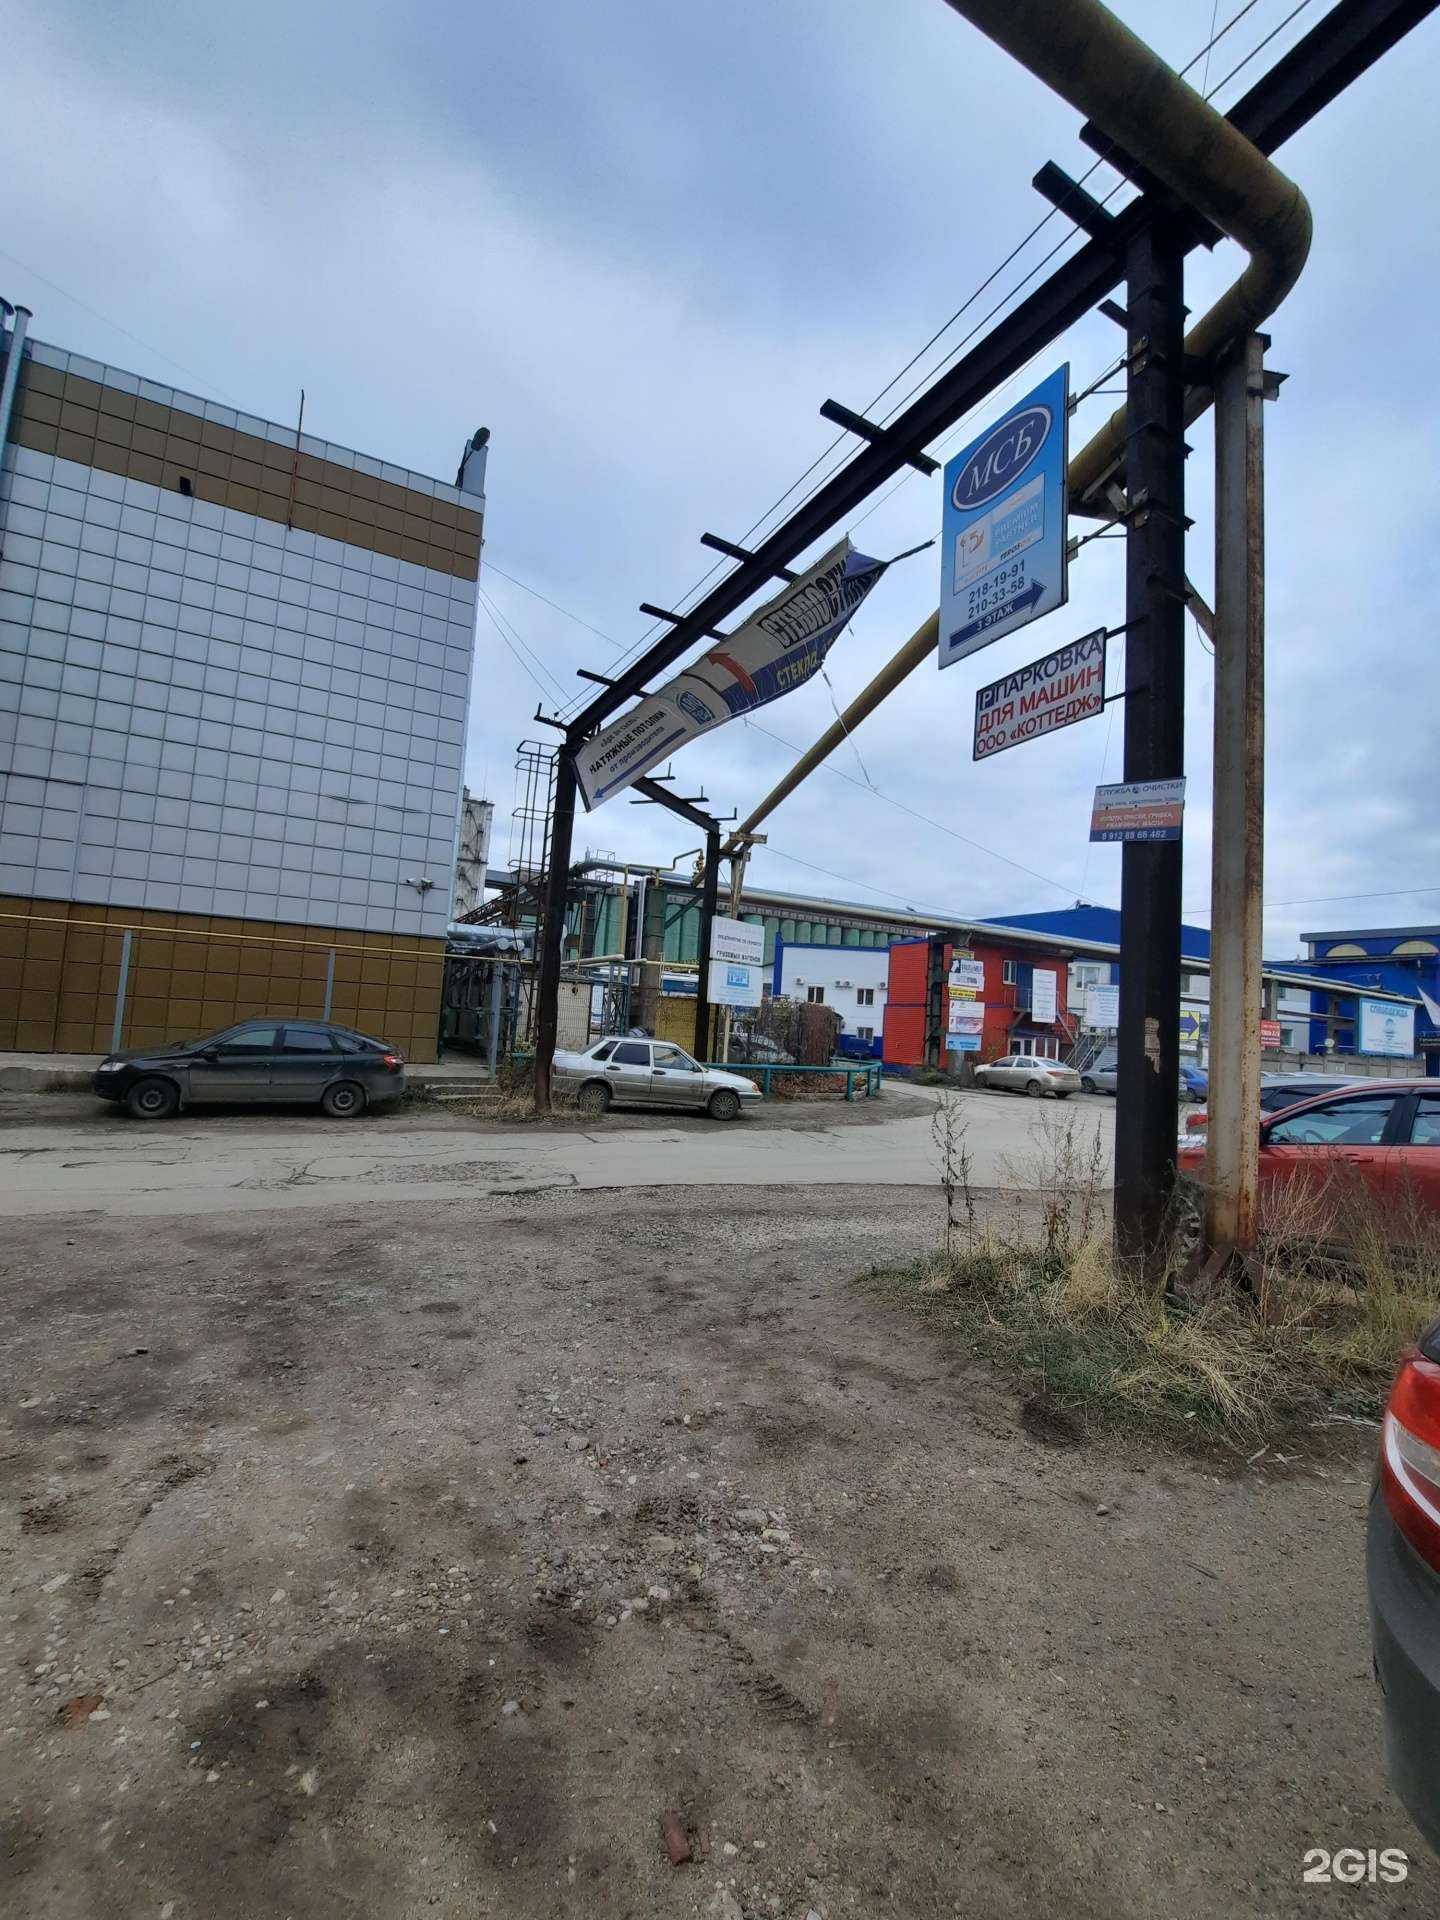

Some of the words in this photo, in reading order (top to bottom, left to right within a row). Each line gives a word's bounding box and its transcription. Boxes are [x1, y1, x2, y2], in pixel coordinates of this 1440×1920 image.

[967, 420, 1034, 498] МСБ
[968, 576, 1025, 619] 210-33-58
[969, 559, 1025, 604] 218-19-91
[984, 602, 1015, 627] ЭТАЖ
[995, 637, 1102, 701] ПАРКОВКА
[977, 701, 1014, 736] ДЛЯ
[1020, 661, 1103, 715] МАШИН
[589, 733, 634, 774] НАТЯЖНЫЕ
[632, 710, 667, 740] ПОТОЛКИ
[976, 731, 1006, 754] ООО
